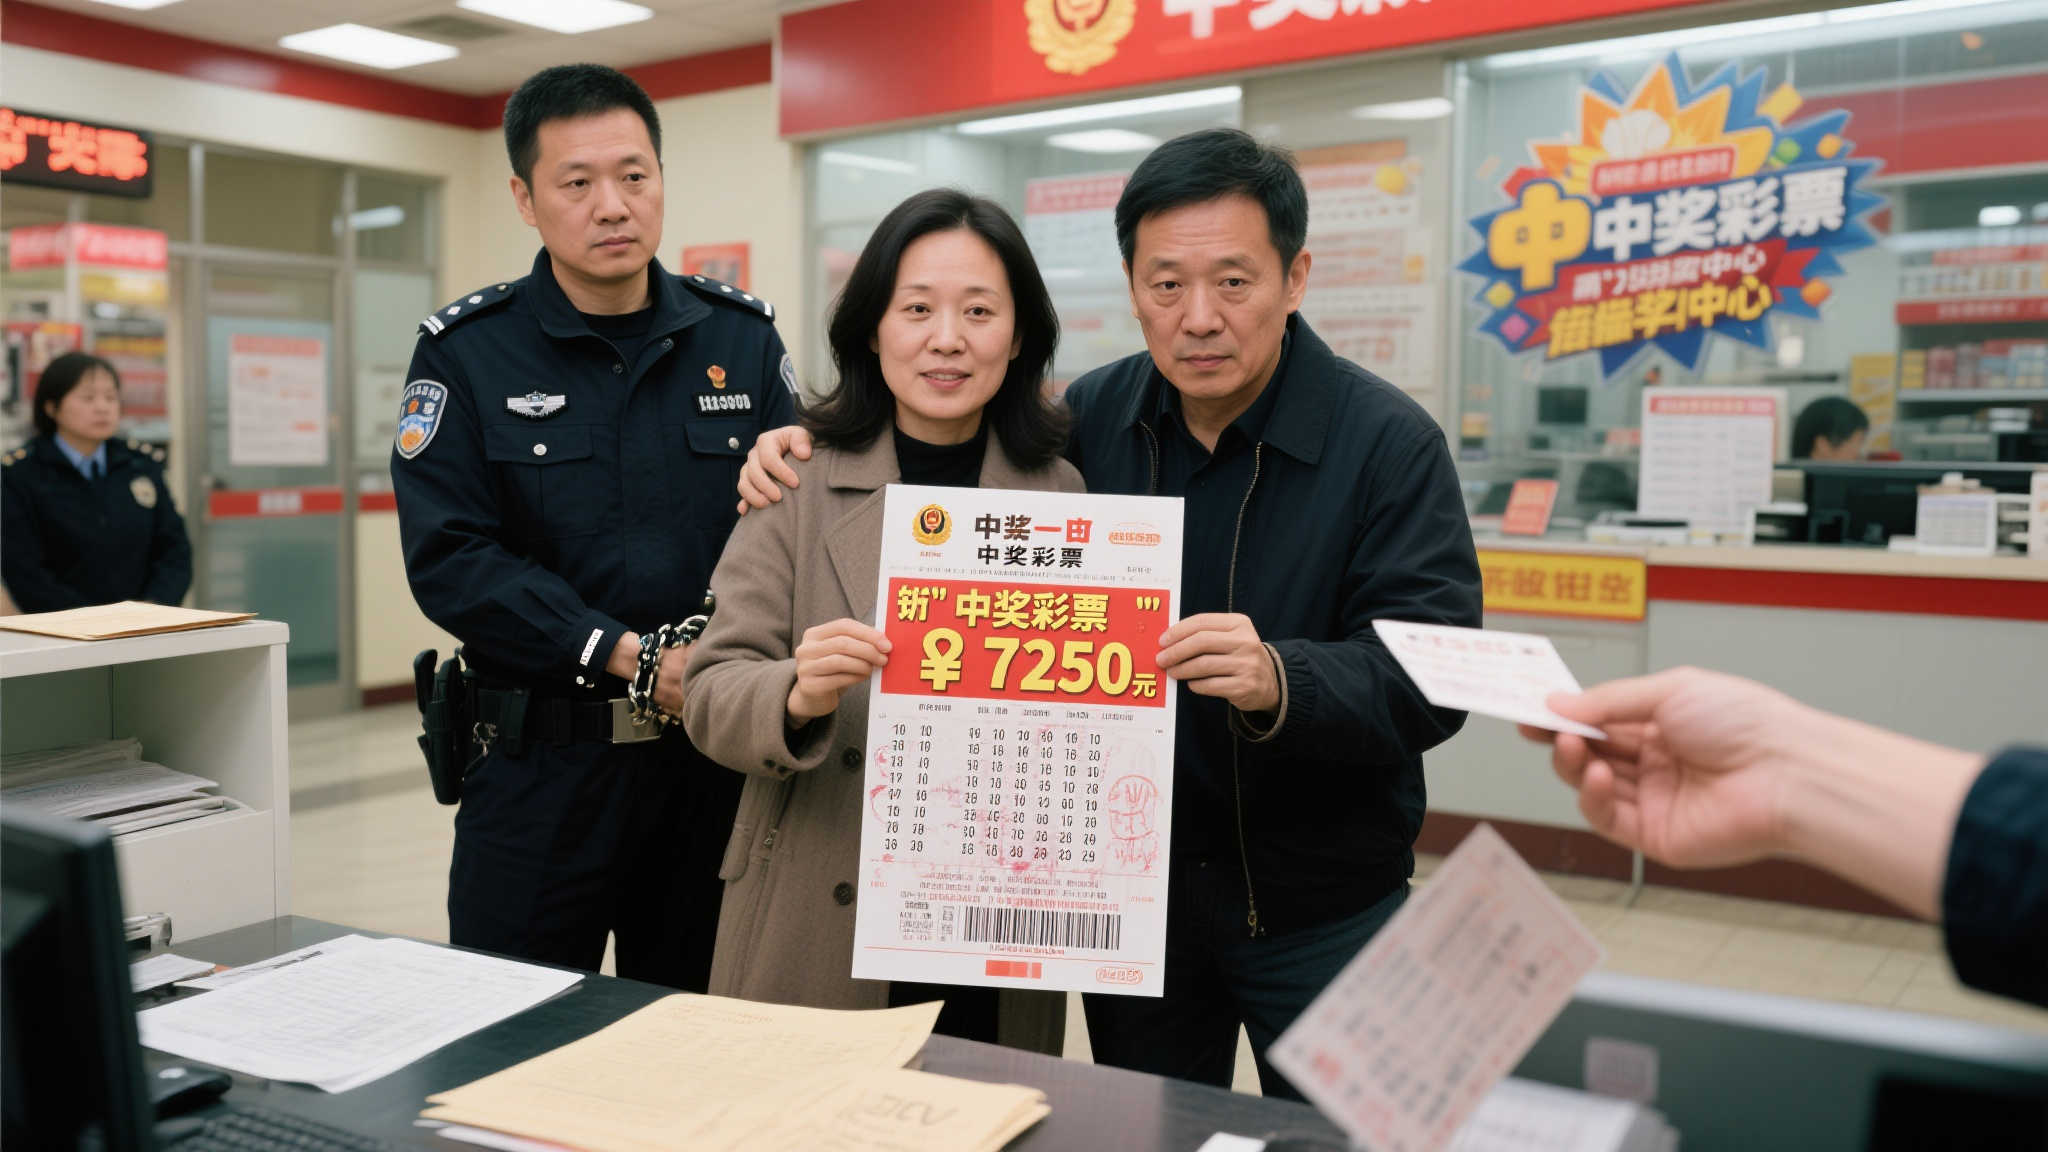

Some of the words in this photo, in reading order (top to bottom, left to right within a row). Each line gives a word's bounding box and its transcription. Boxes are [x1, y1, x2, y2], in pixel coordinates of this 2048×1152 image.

[1489, 182, 1592, 291] 中
[1594, 166, 1848, 262] 中奖彩票
[977, 544, 1084, 569] 中奖彩票
[955, 588, 1110, 633] 中奖彩票
